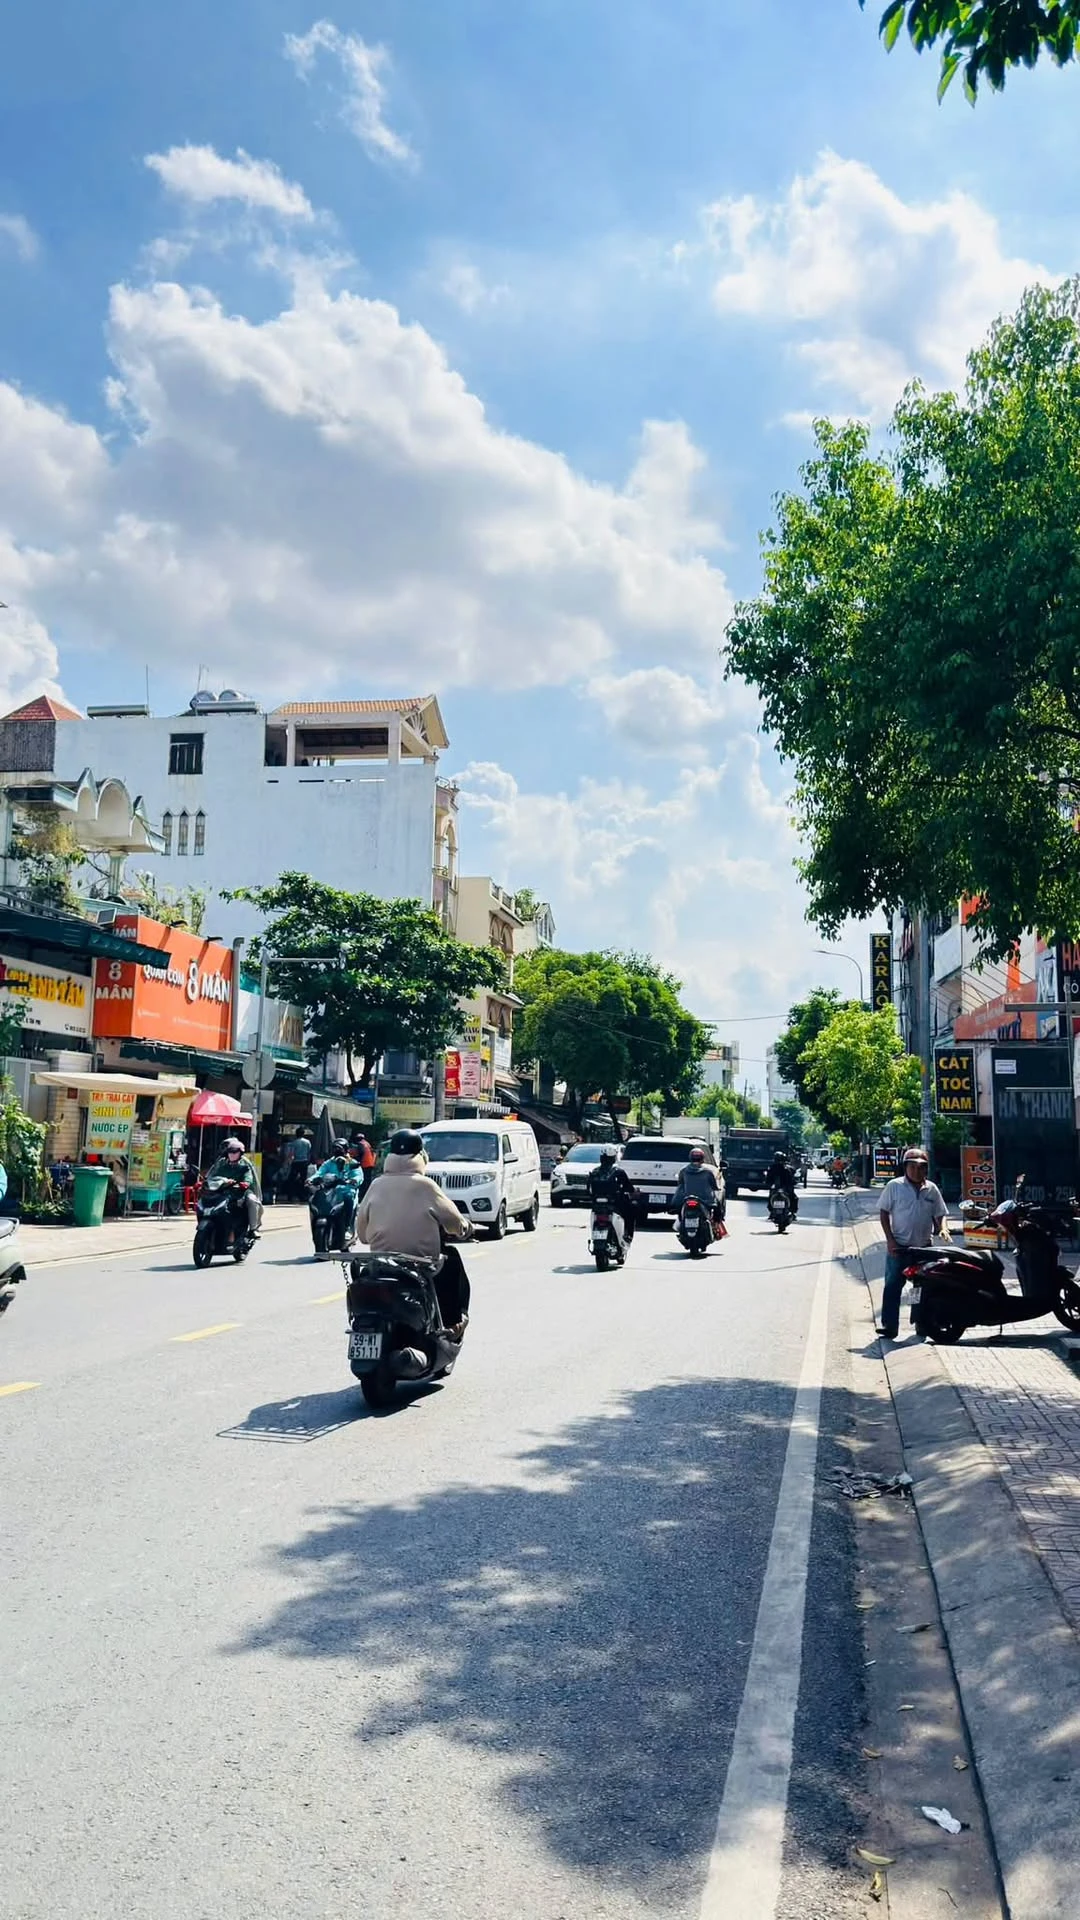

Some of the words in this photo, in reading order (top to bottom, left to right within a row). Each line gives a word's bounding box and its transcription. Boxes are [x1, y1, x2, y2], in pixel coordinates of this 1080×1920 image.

[109, 961, 122, 980] 8
[187, 962, 199, 1001] 8
[96, 984, 134, 1000] MÂN
[940, 1097, 972, 1110] NAM
